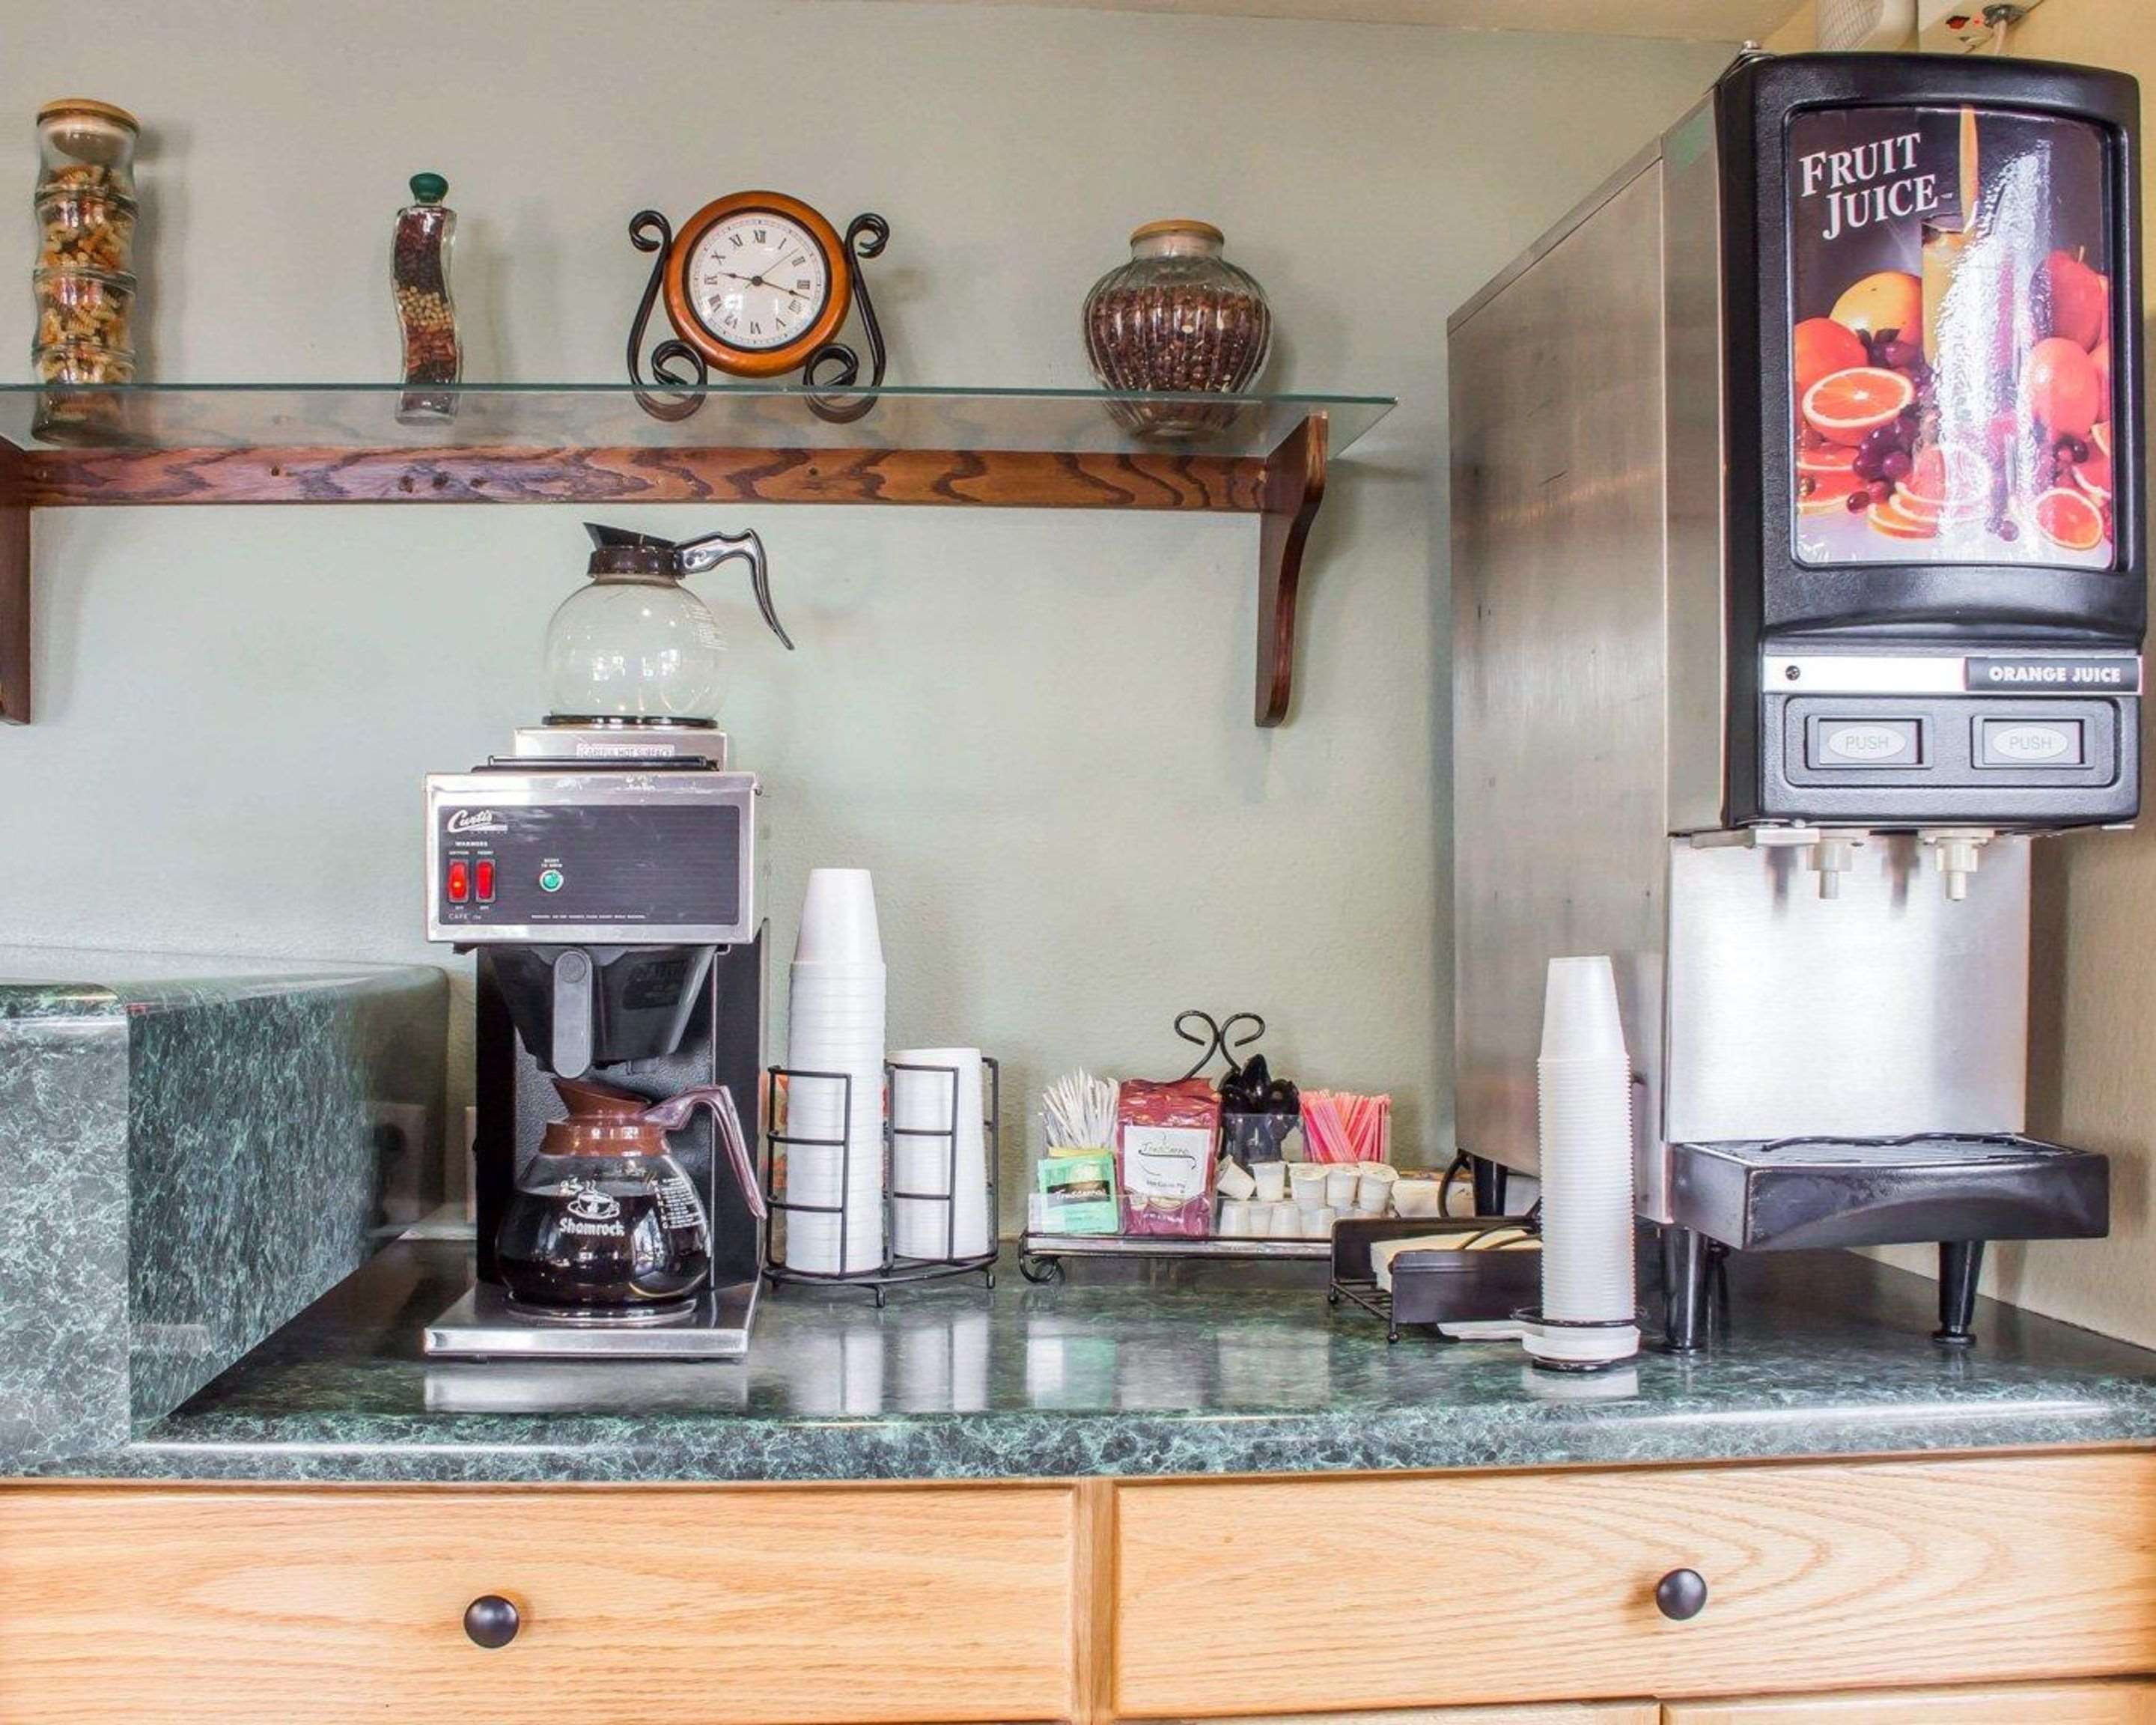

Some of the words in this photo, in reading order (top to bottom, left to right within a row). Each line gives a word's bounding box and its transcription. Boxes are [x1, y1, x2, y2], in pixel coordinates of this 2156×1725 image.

[1799, 132, 1922, 197] FRUIT
[1822, 173, 1938, 240] JUICE
[1988, 665, 2067, 682] ORANGE
[2071, 665, 2122, 683] JUICE
[1845, 737, 1889, 749] PUSH
[2009, 737, 2053, 749] PUSH
[559, 1217, 624, 1236] Shamrock
